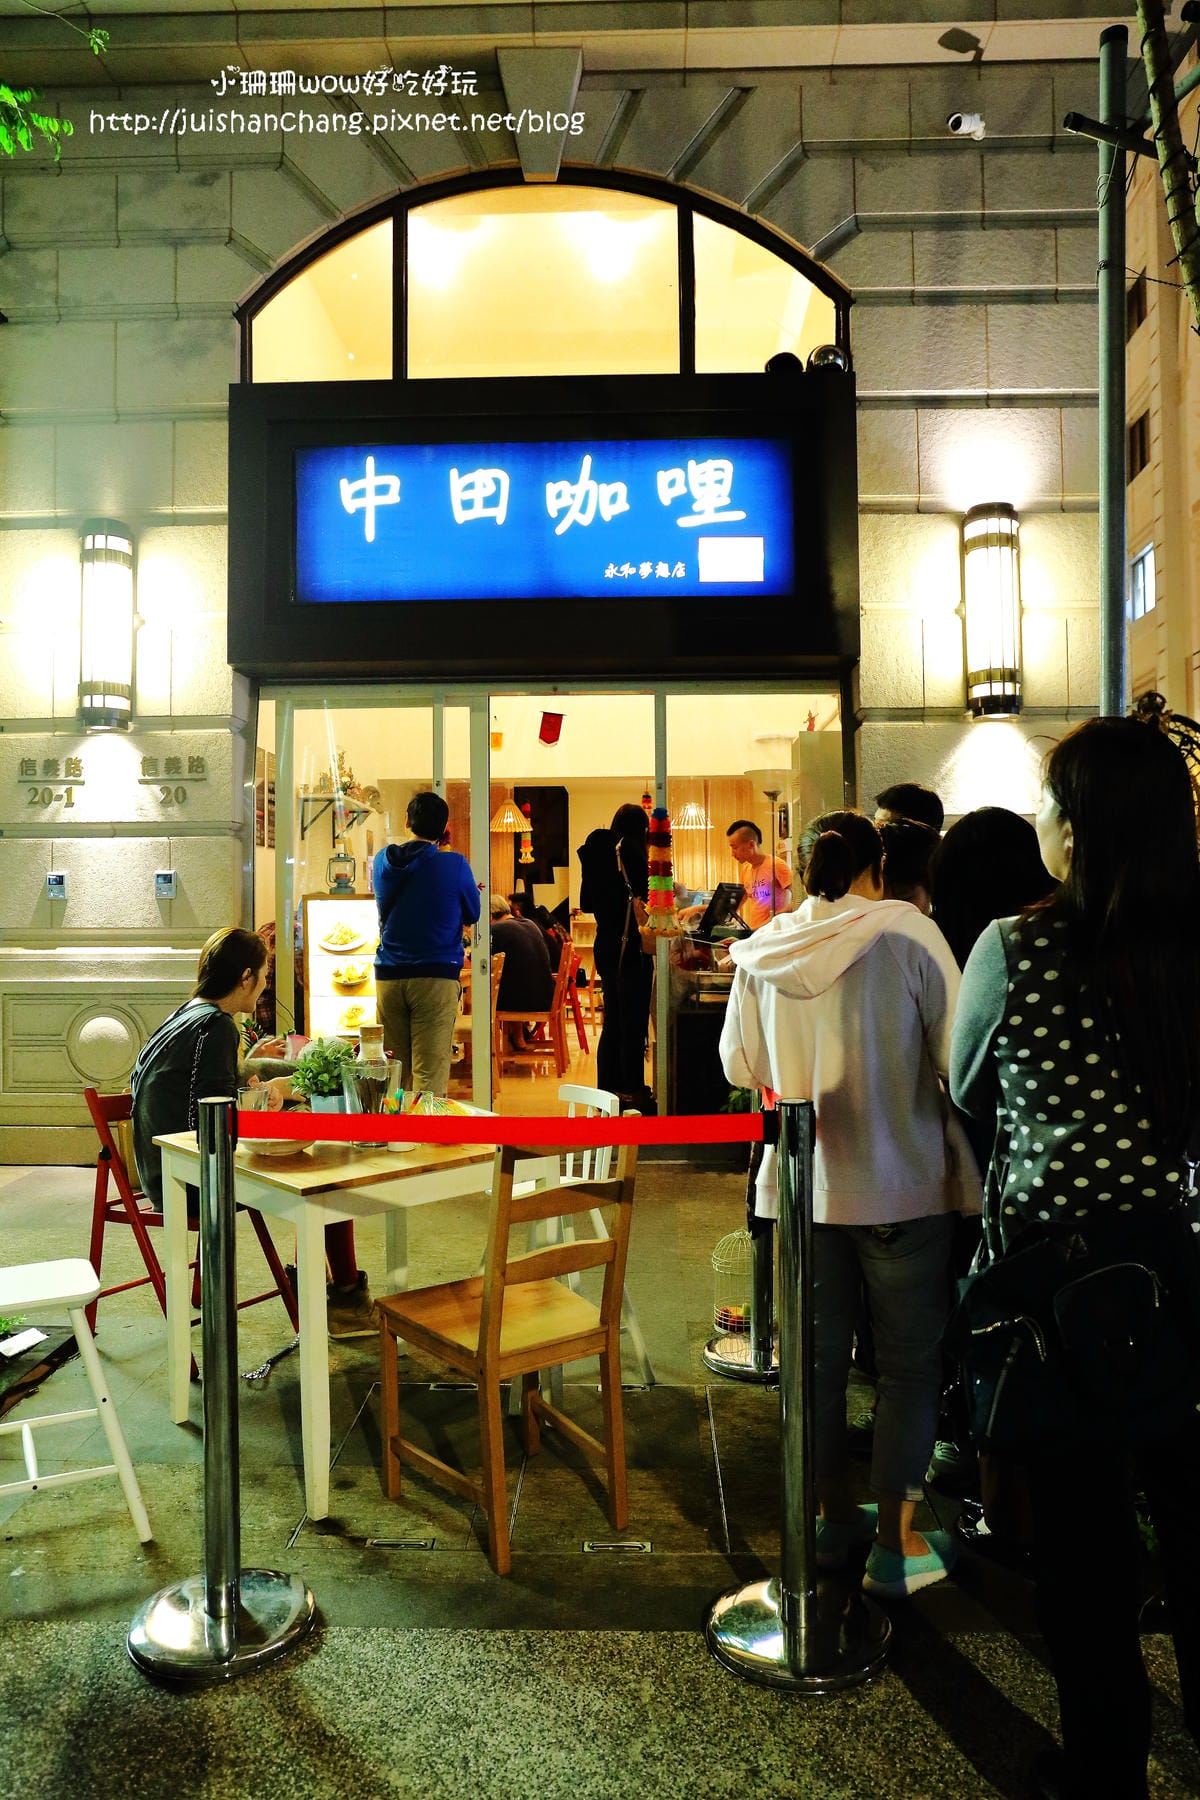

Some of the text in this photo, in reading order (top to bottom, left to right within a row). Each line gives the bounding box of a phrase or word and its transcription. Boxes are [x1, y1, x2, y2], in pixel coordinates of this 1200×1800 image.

[339, 454, 747, 543] 中田咖哩
[20, 757, 84, 778] 信義路
[140, 755, 206, 777] 信義路
[27, 786, 75, 808] 20-1
[159, 786, 188, 807] 20
